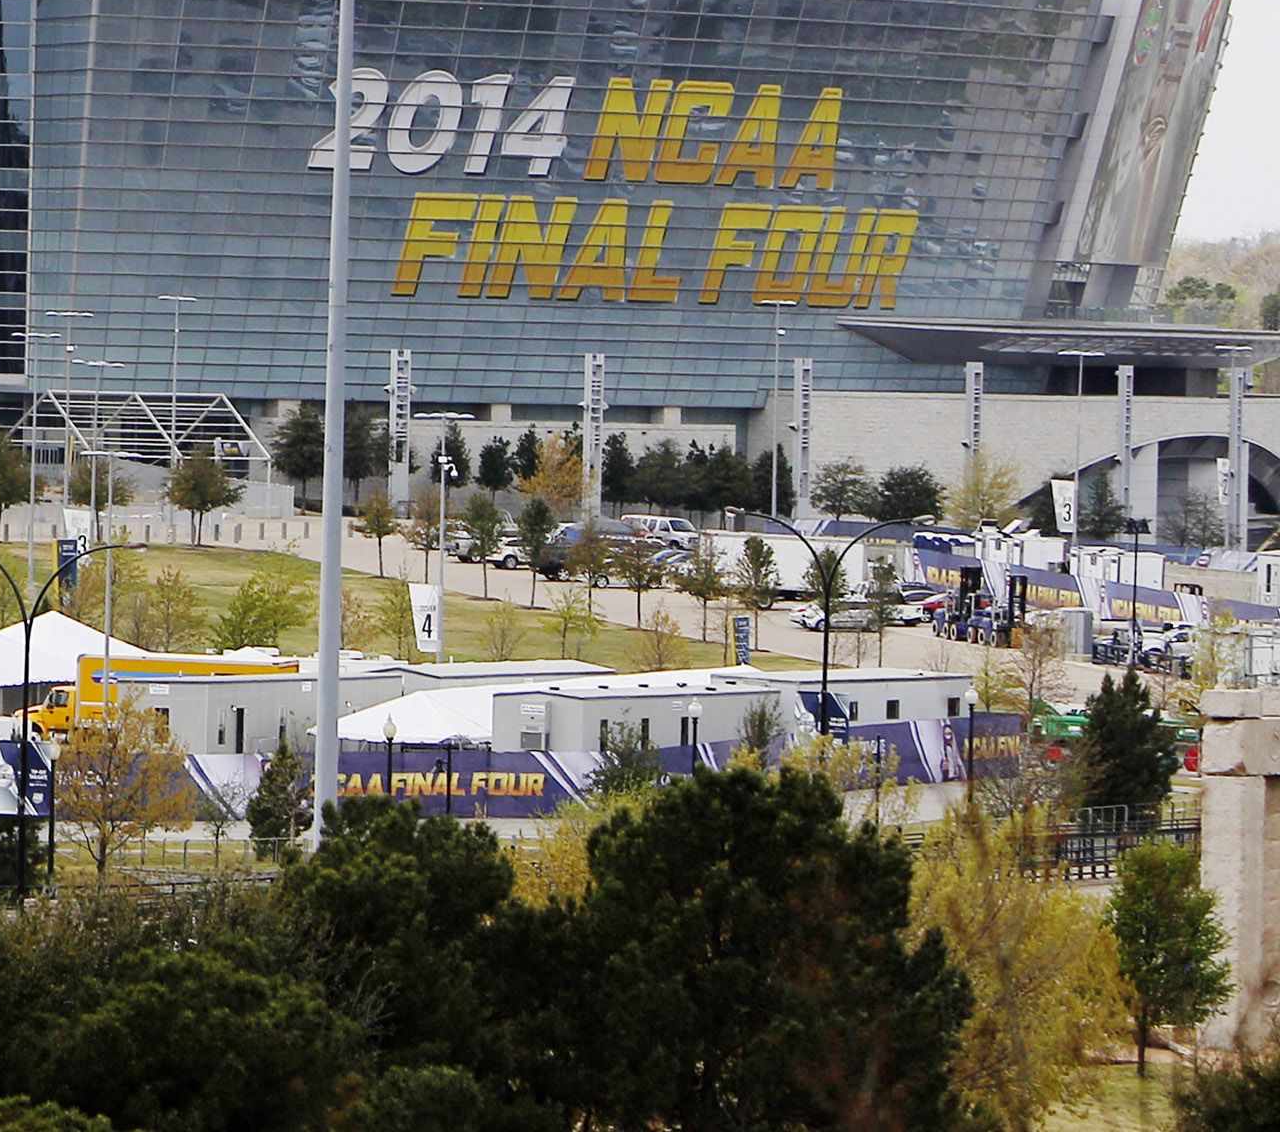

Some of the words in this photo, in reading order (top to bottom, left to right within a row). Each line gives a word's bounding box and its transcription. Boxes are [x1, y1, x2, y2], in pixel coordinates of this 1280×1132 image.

[307, 67, 577, 177] 2014
[583, 77, 845, 190] NCAA
[391, 192, 684, 302] FINAL
[699, 203, 920, 310] FOUR
[1062, 503, 1072, 523] 3
[77, 535, 87, 555] 3
[421, 613, 433, 639] 4
[308, 772, 387, 797] CAA
[390, 772, 466, 797] FINAL
[470, 772, 545, 797] FOUR
